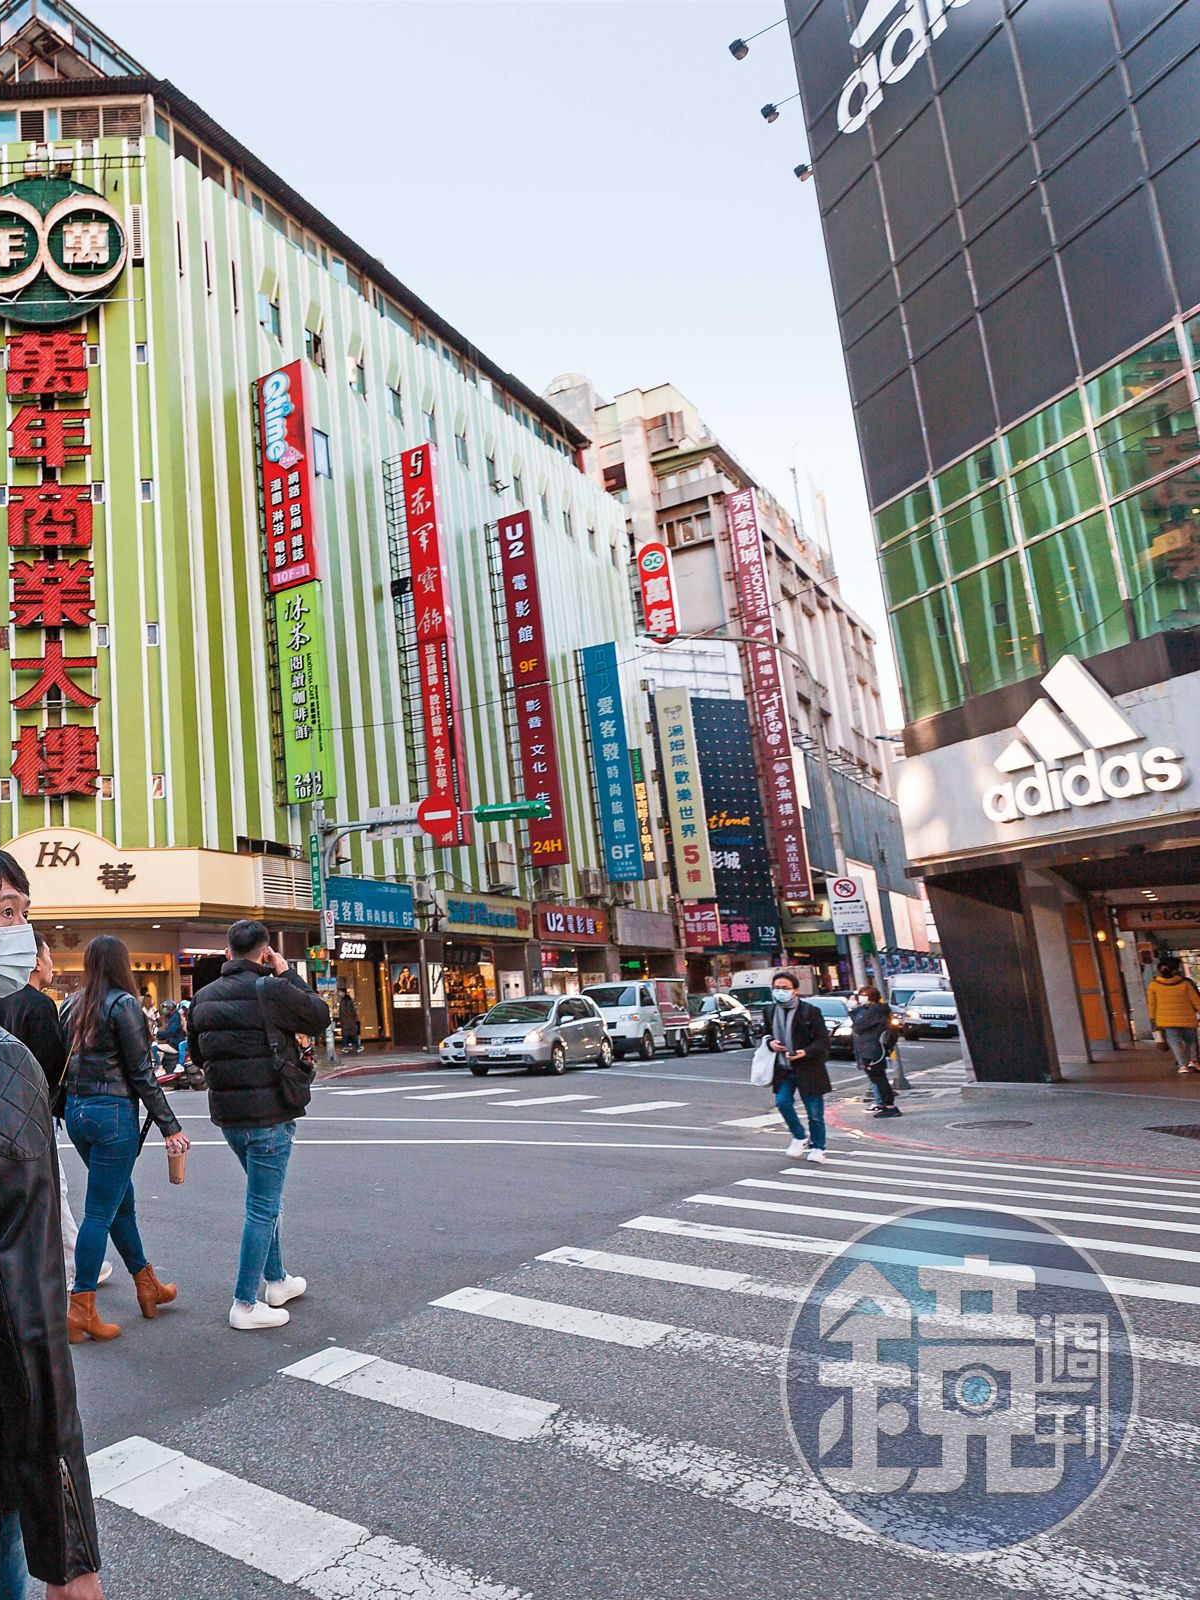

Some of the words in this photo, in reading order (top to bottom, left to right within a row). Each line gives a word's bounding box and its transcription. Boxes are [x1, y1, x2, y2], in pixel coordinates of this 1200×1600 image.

[837, 0, 973, 133] adi
[504, 523, 525, 558] U2
[6, 331, 101, 797] 萬年商業大樓
[512, 573, 534, 643] 電影館
[519, 658, 538, 673] 9F
[983, 747, 1184, 822] adidas
[708, 812, 750, 830] time
[533, 839, 562, 854] 24H
[611, 844, 635, 860] 6F
[547, 912, 564, 932] U2
[685, 911, 715, 922] U2
